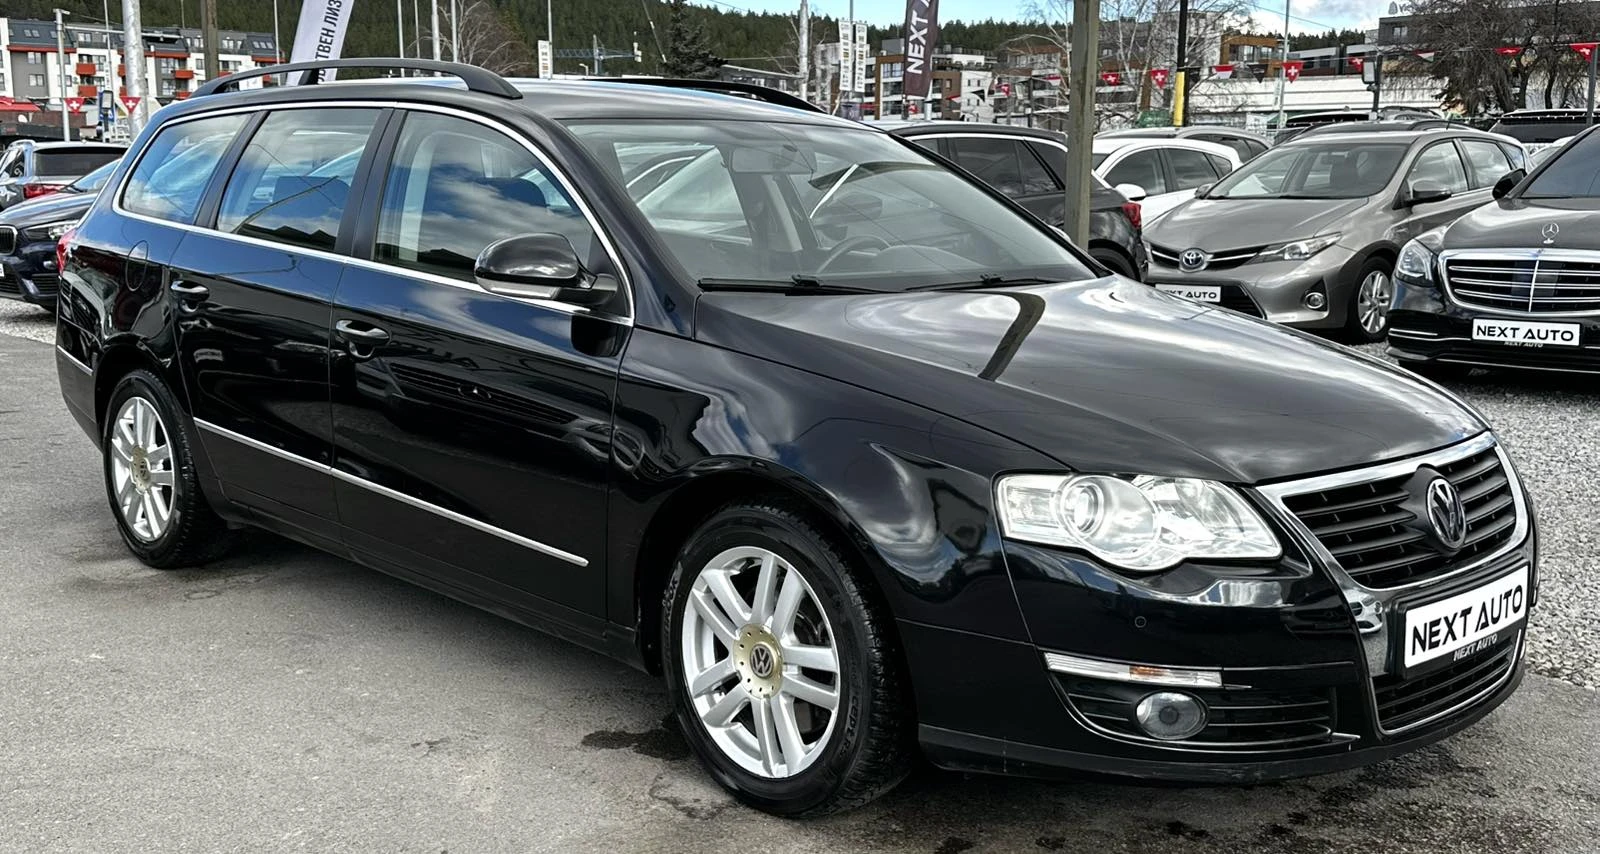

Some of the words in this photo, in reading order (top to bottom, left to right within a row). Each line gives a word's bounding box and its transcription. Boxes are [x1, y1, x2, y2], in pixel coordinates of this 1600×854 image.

[906, 10, 929, 75] NEXT
[1185, 291, 1217, 299] AUTO
[1476, 325, 1520, 338] NEXT
[1523, 328, 1574, 342] AUTO
[1411, 606, 1473, 656] NEXT
[1474, 584, 1523, 633] AUTO
[1453, 641, 1477, 661] NEXT
[1476, 633, 1498, 652] AUTO
